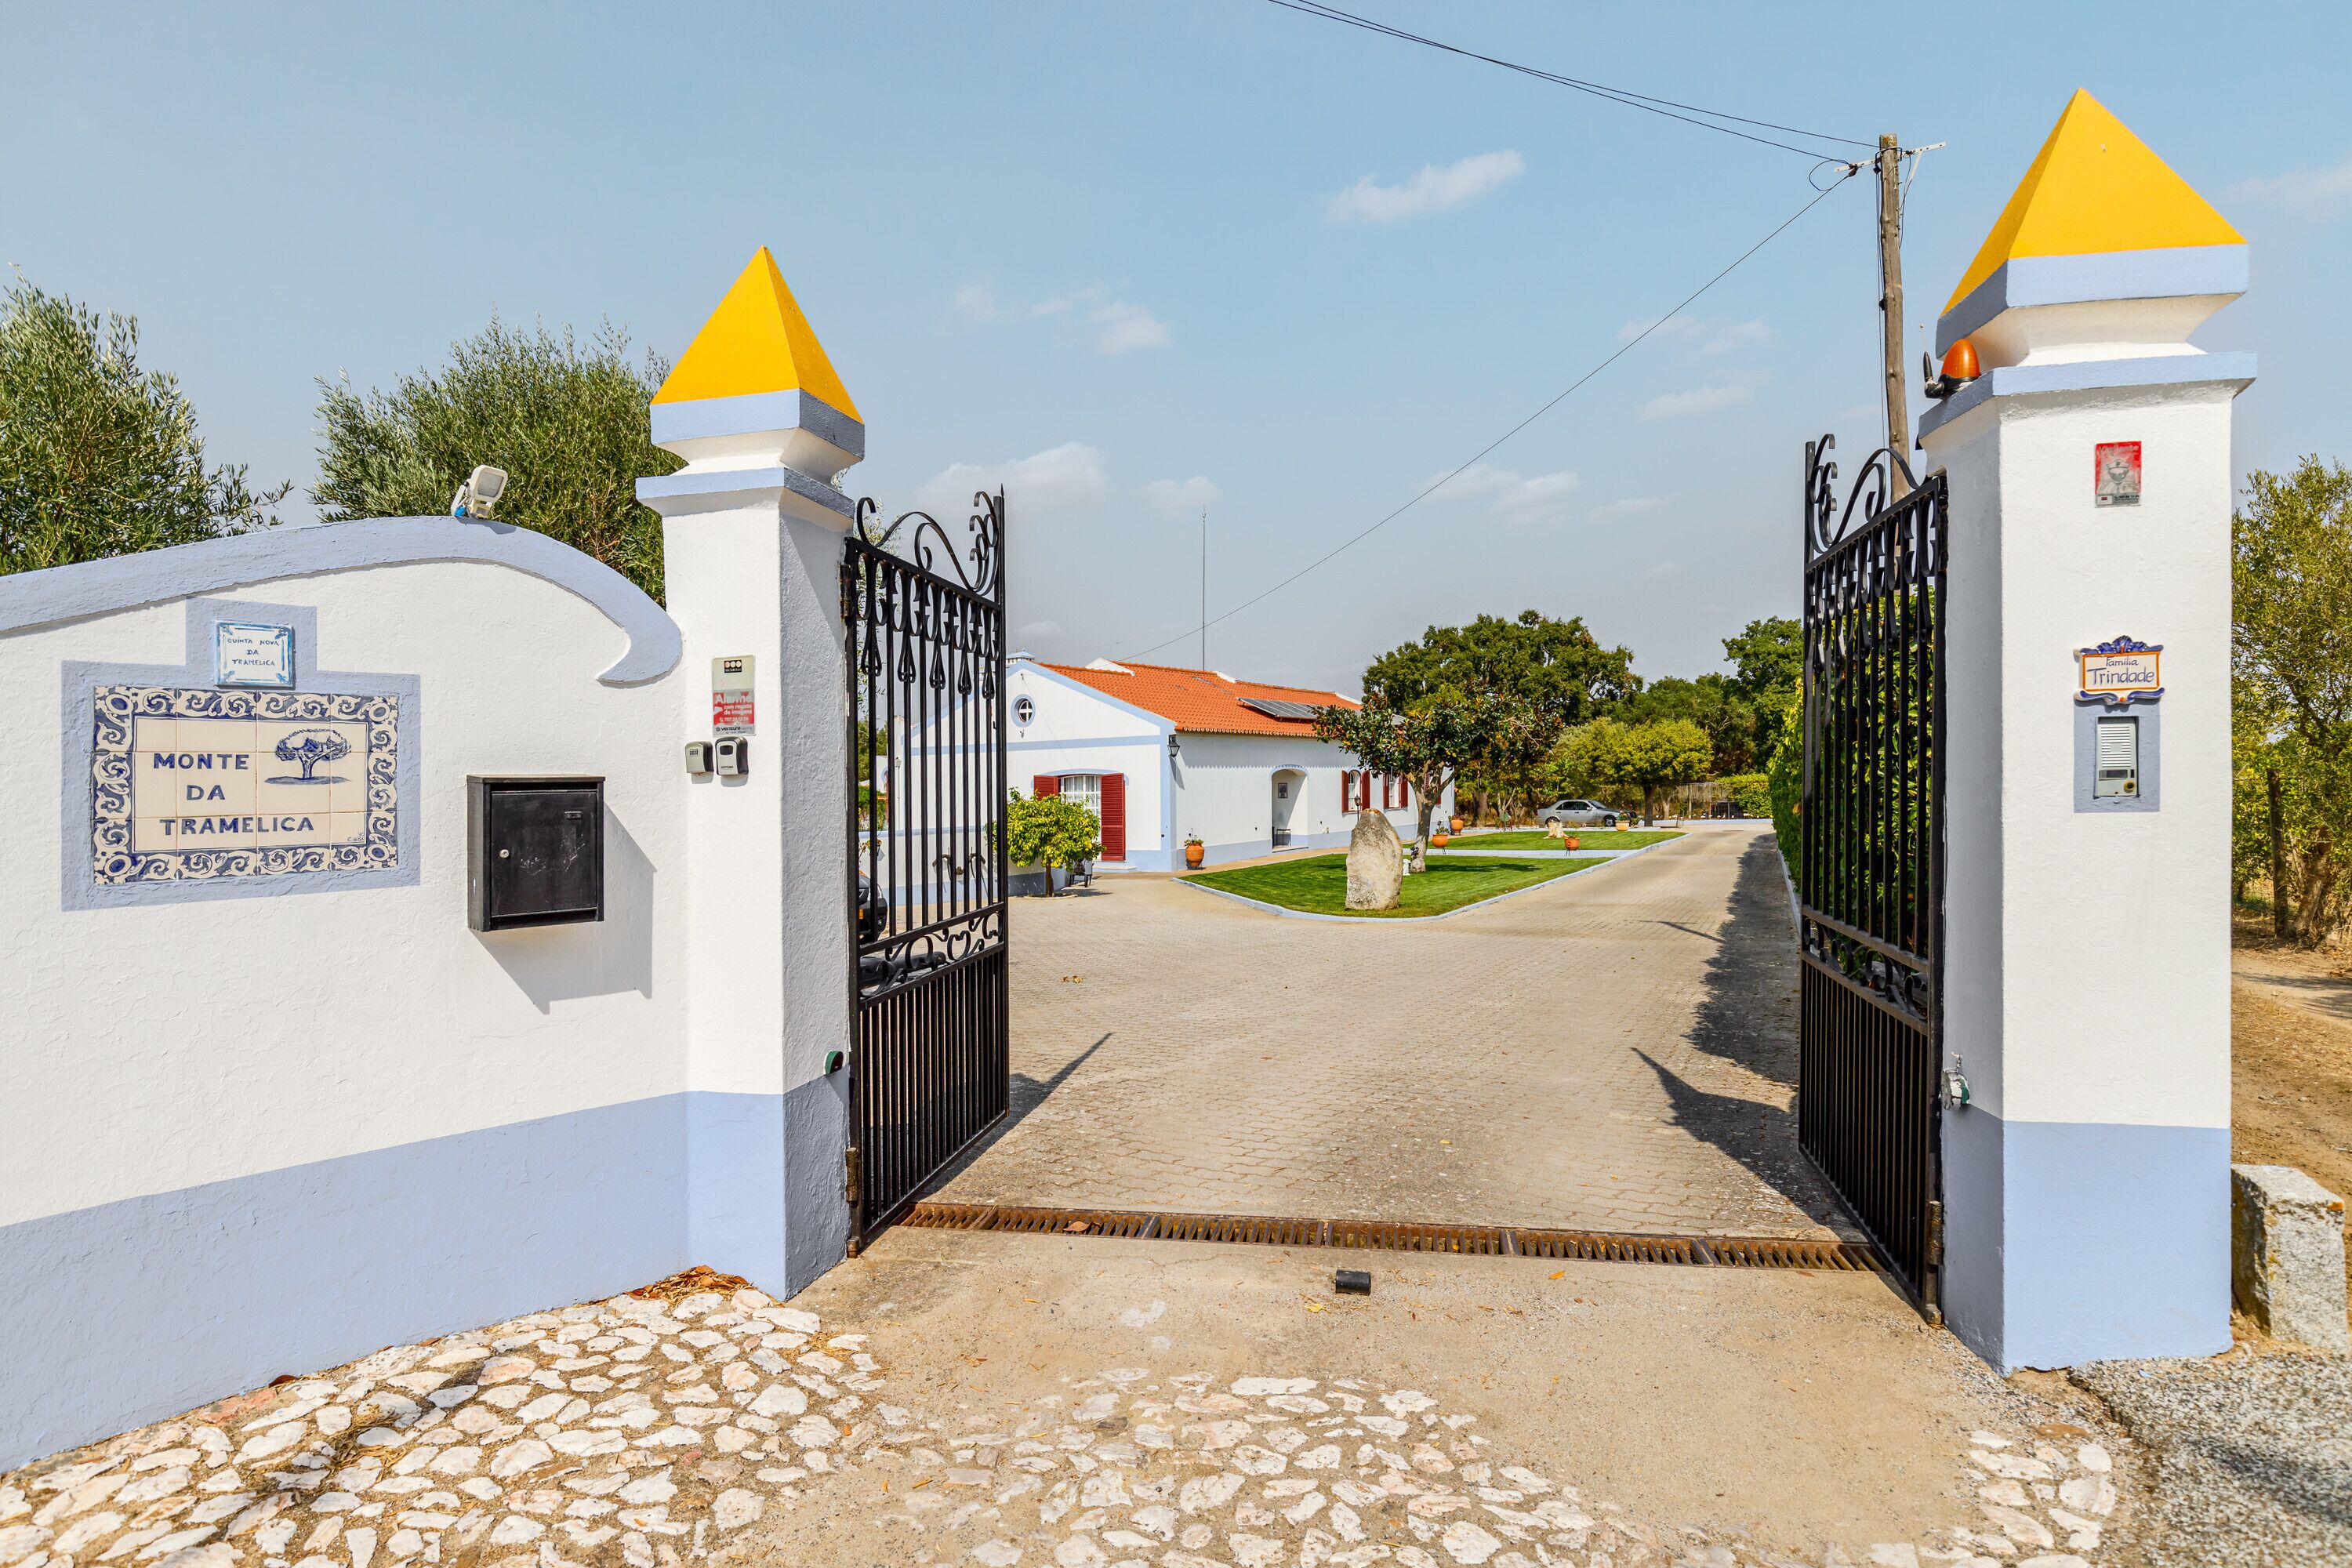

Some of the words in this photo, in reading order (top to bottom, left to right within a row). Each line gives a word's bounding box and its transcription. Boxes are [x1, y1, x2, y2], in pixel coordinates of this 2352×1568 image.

[2086, 666, 2154, 684] Trindade
[154, 753, 249, 770] MONTE
[186, 784, 226, 800] DA
[159, 817, 314, 836] TRAMELICA
